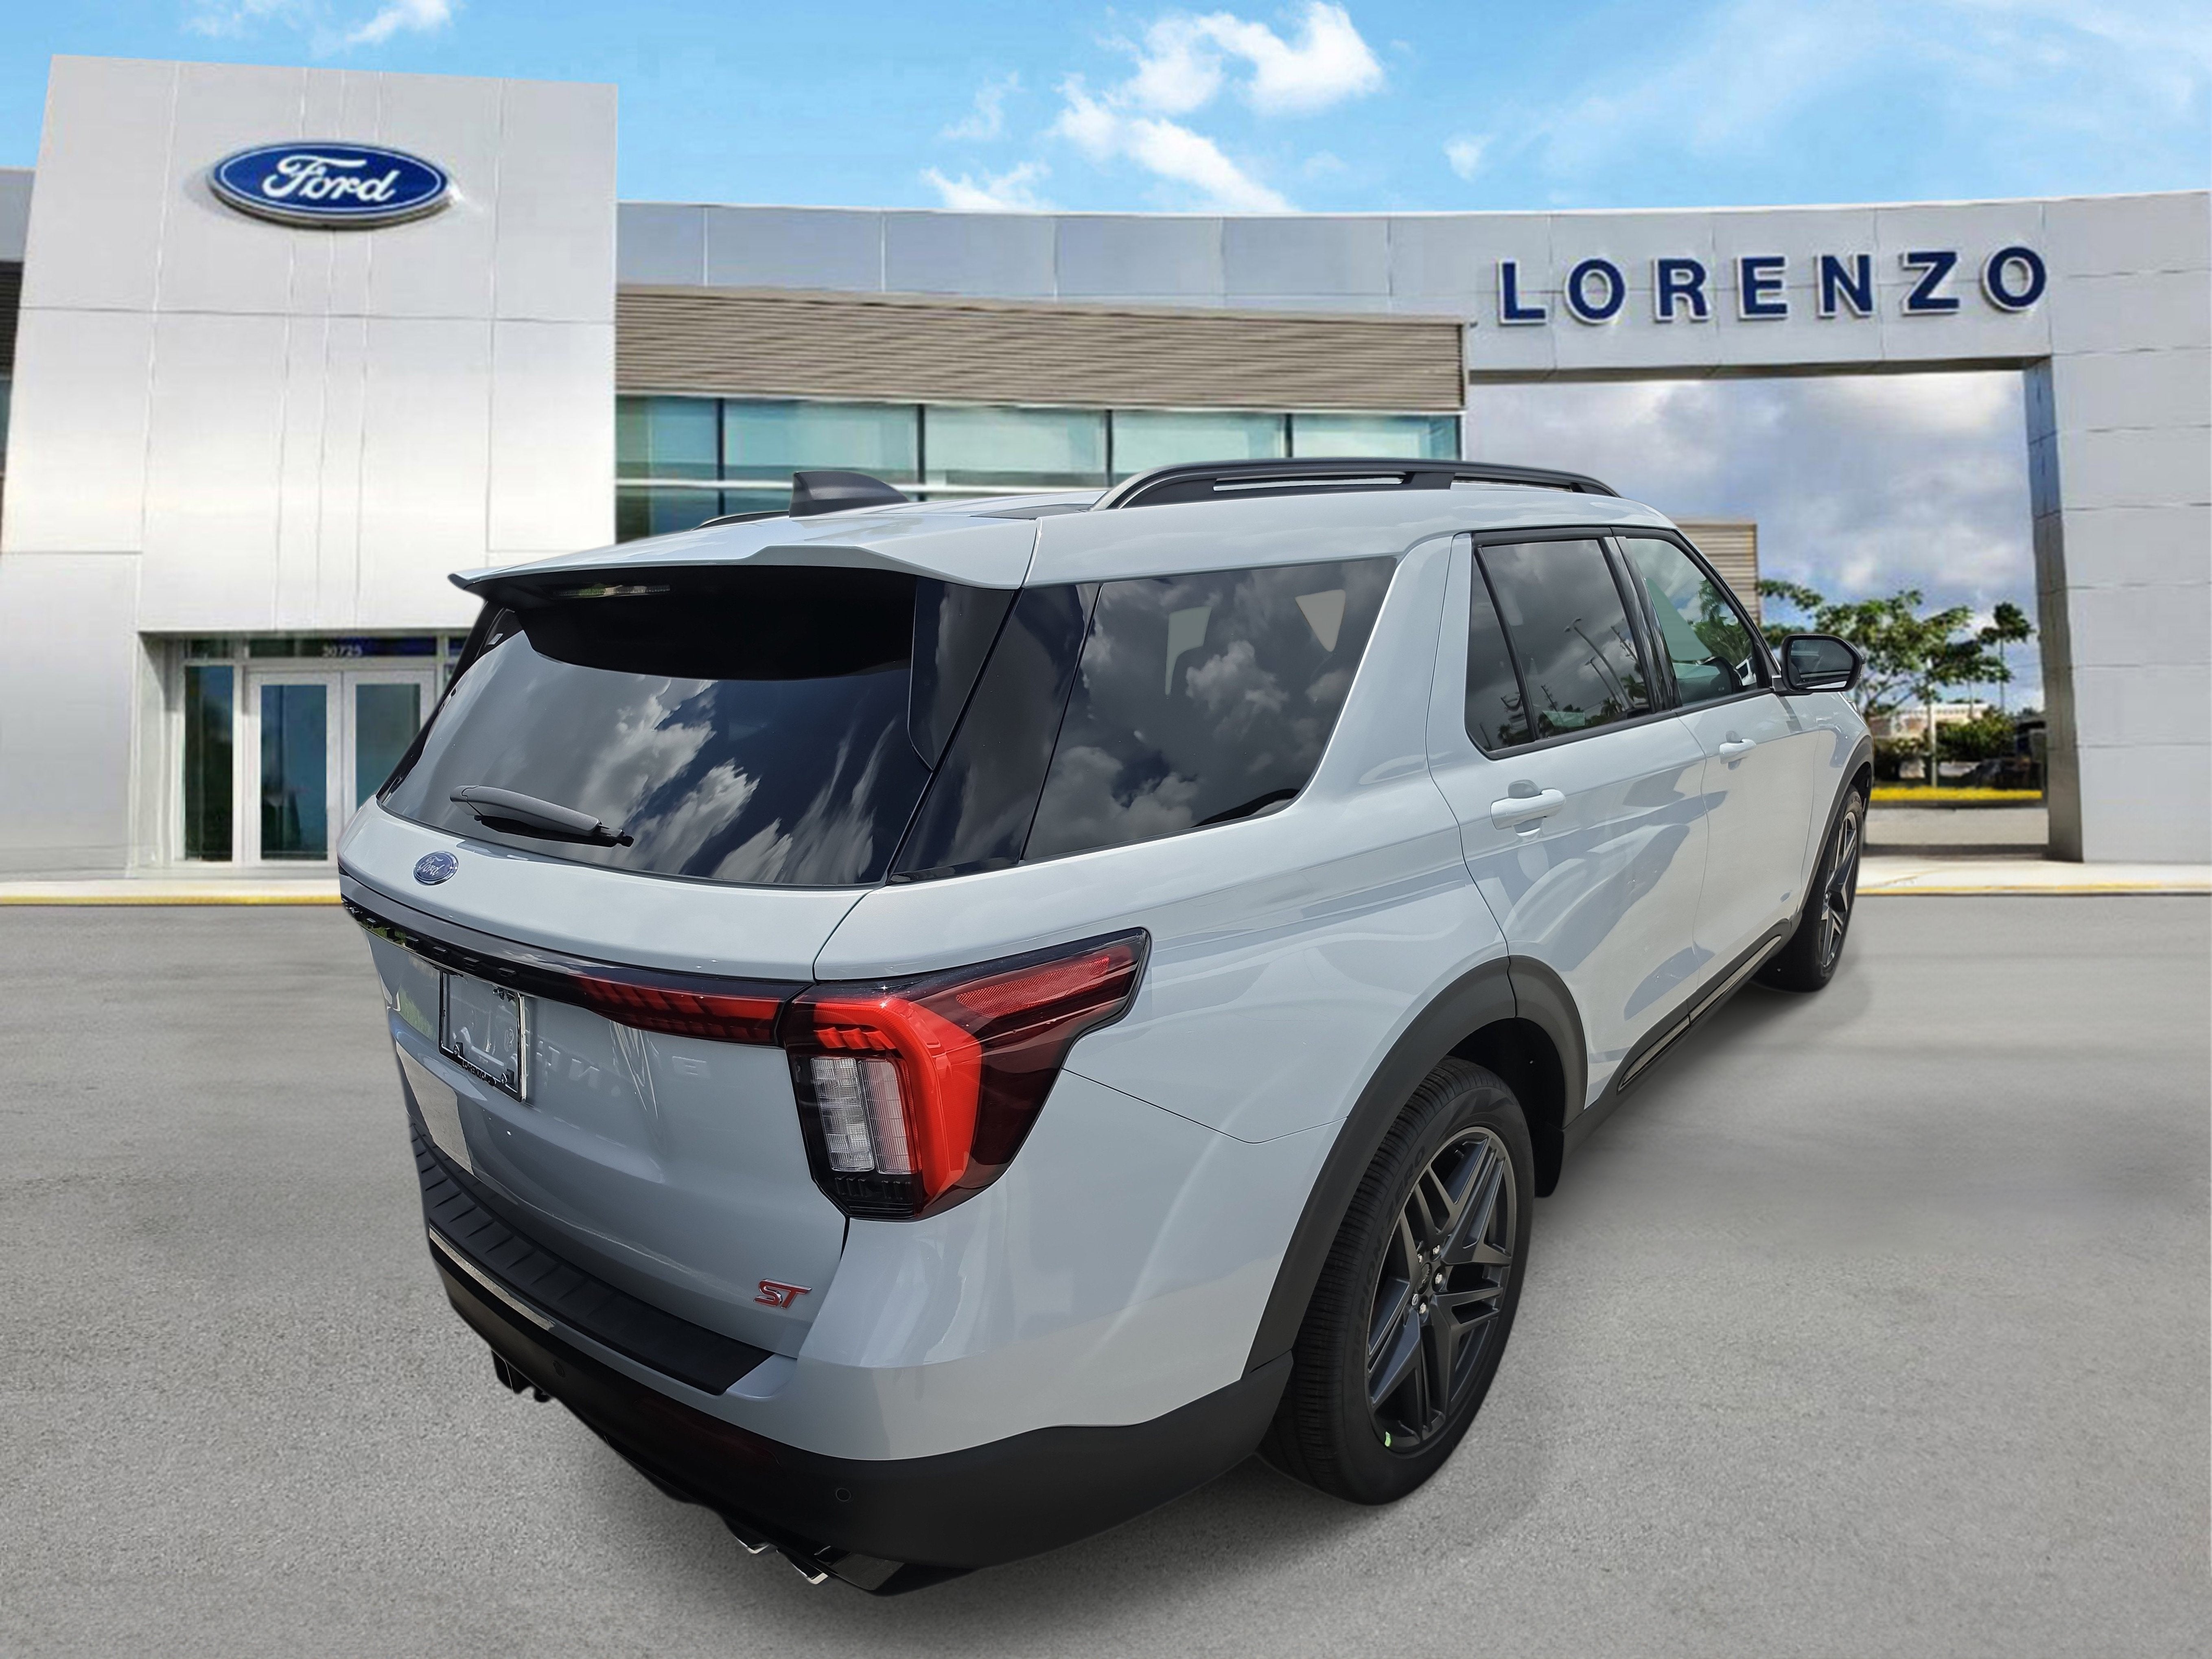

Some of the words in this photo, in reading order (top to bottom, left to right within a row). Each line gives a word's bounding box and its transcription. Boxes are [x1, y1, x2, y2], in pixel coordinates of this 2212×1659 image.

[262, 155, 400, 201] Ford
[1497, 246, 2047, 325] LORENZO
[416, 856, 445, 876] Ford
[1386, 1145, 1426, 1228] ZERO
[753, 1278, 813, 1309] ST
